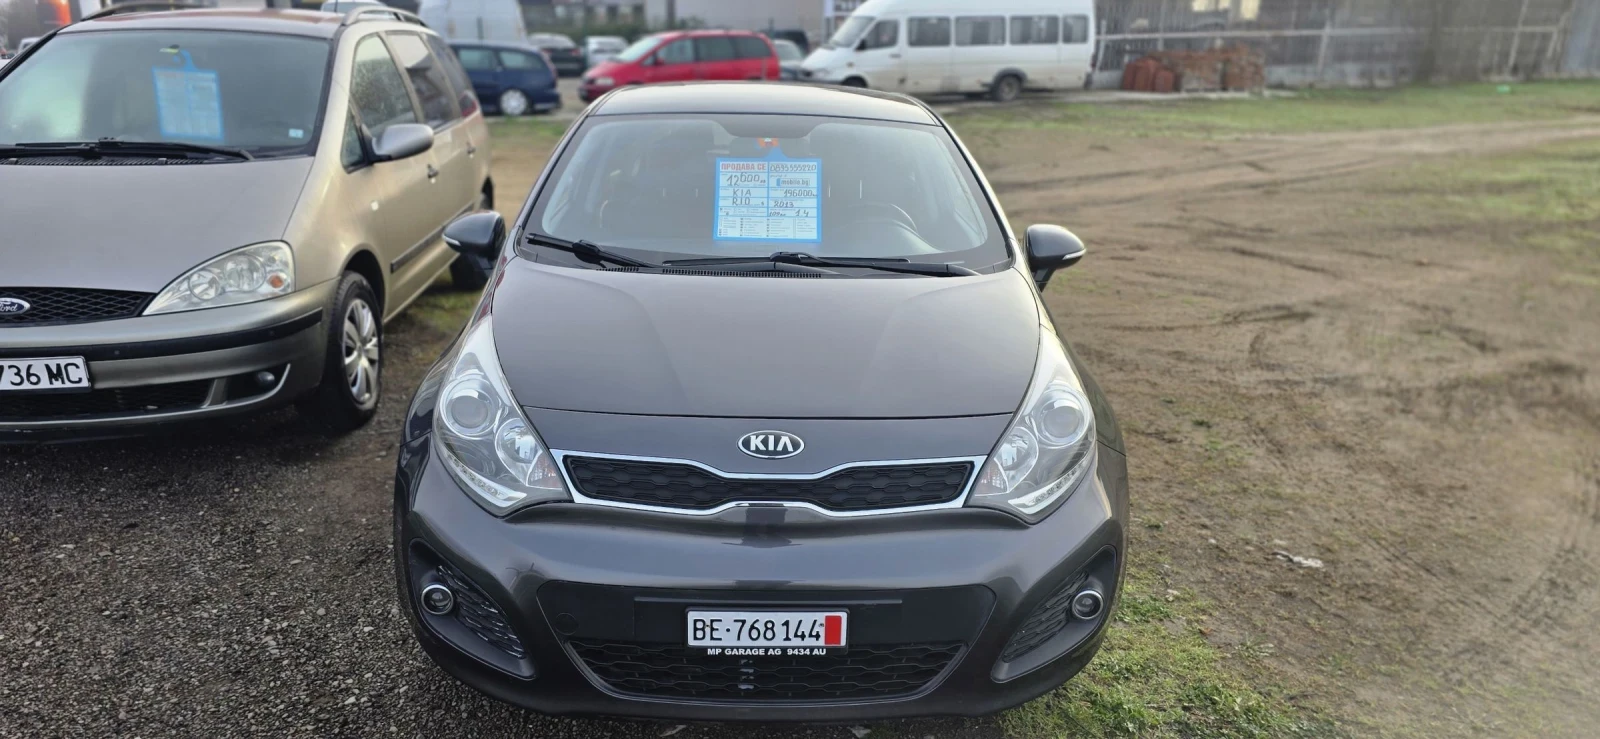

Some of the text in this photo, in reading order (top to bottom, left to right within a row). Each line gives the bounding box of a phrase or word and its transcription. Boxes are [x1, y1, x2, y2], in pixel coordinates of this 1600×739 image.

[721, 163, 755, 171] ПРОДАВА
[732, 188, 752, 197] KIA
[732, 197, 751, 206] RIO
[0, 362, 83, 387] 36 MC
[749, 434, 794, 452] KIA
[724, 648, 765, 656] GARAGE
[767, 648, 782, 656] AG
